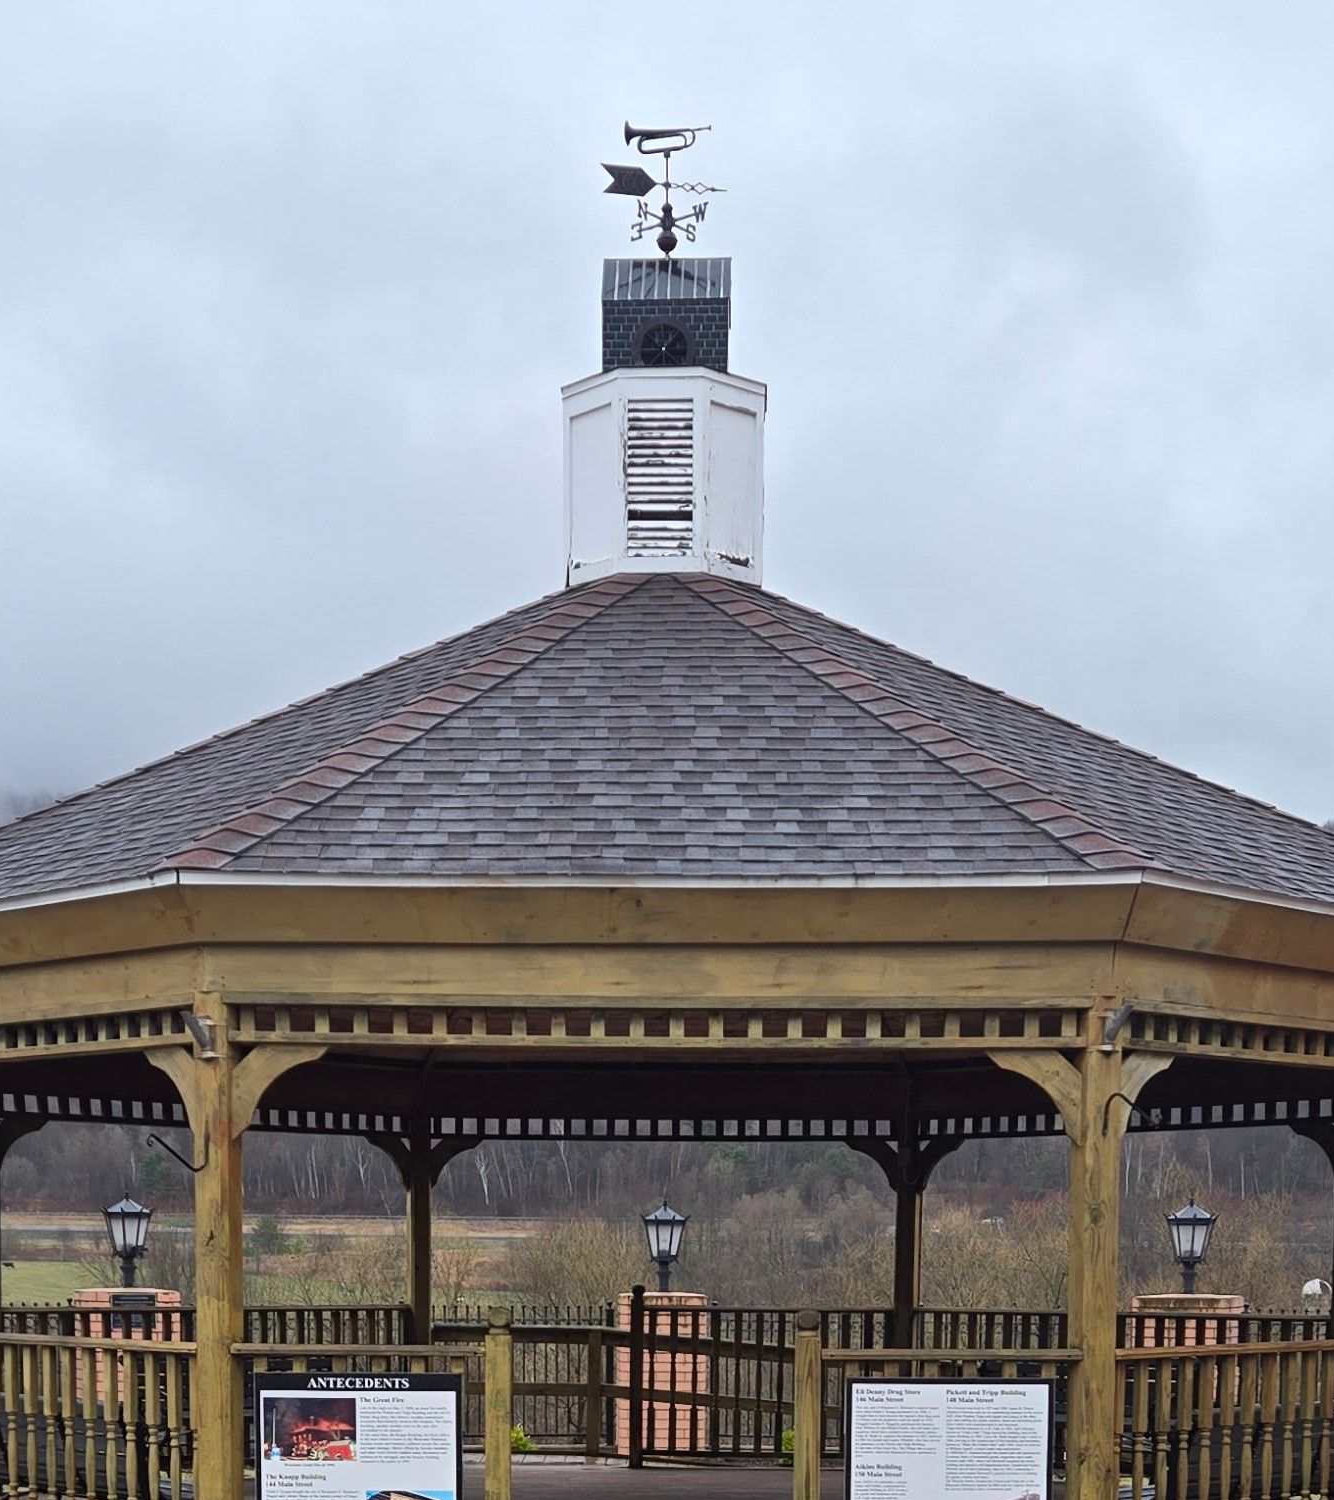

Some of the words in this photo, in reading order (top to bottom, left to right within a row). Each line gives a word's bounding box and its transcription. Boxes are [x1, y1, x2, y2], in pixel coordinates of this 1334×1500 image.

[637, 199, 648, 221] N
[692, 201, 709, 223] W
[686, 223, 696, 243] S
[307, 1377, 410, 1389] ANTECEDENTS
[1001, 1389, 1026, 1397] Building
